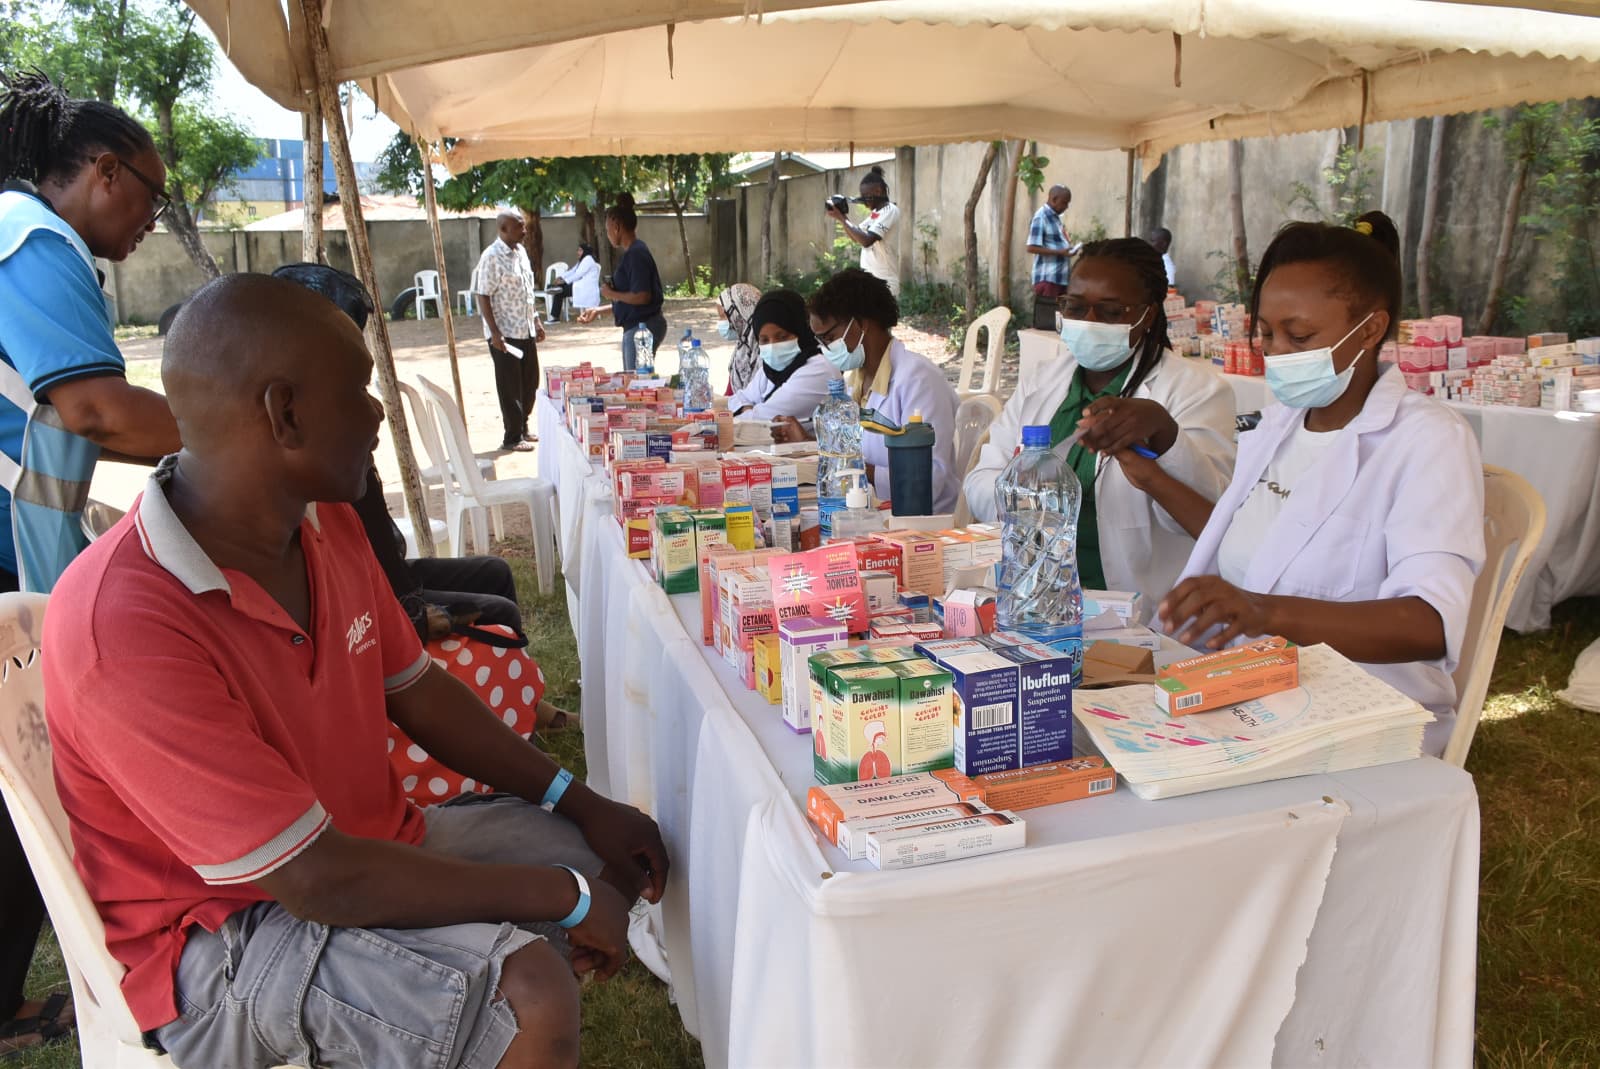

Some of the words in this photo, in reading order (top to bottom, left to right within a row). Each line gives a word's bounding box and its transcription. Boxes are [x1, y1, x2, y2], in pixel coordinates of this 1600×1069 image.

[866, 556, 899, 570] Enervit
[779, 605, 809, 618] CETAMOL
[742, 614, 771, 626] CETAMOL
[1022, 672, 1070, 691] Ibuflam
[852, 688, 895, 704] Dawahist
[910, 686, 945, 700] Dawahist
[1027, 694, 1066, 706] Suspension
[1230, 705, 1261, 728] HEALTH
[843, 775, 921, 790] DAWA-CORT
[857, 787, 936, 804] DAWA-CORT
[894, 807, 950, 821] XTRADERM
